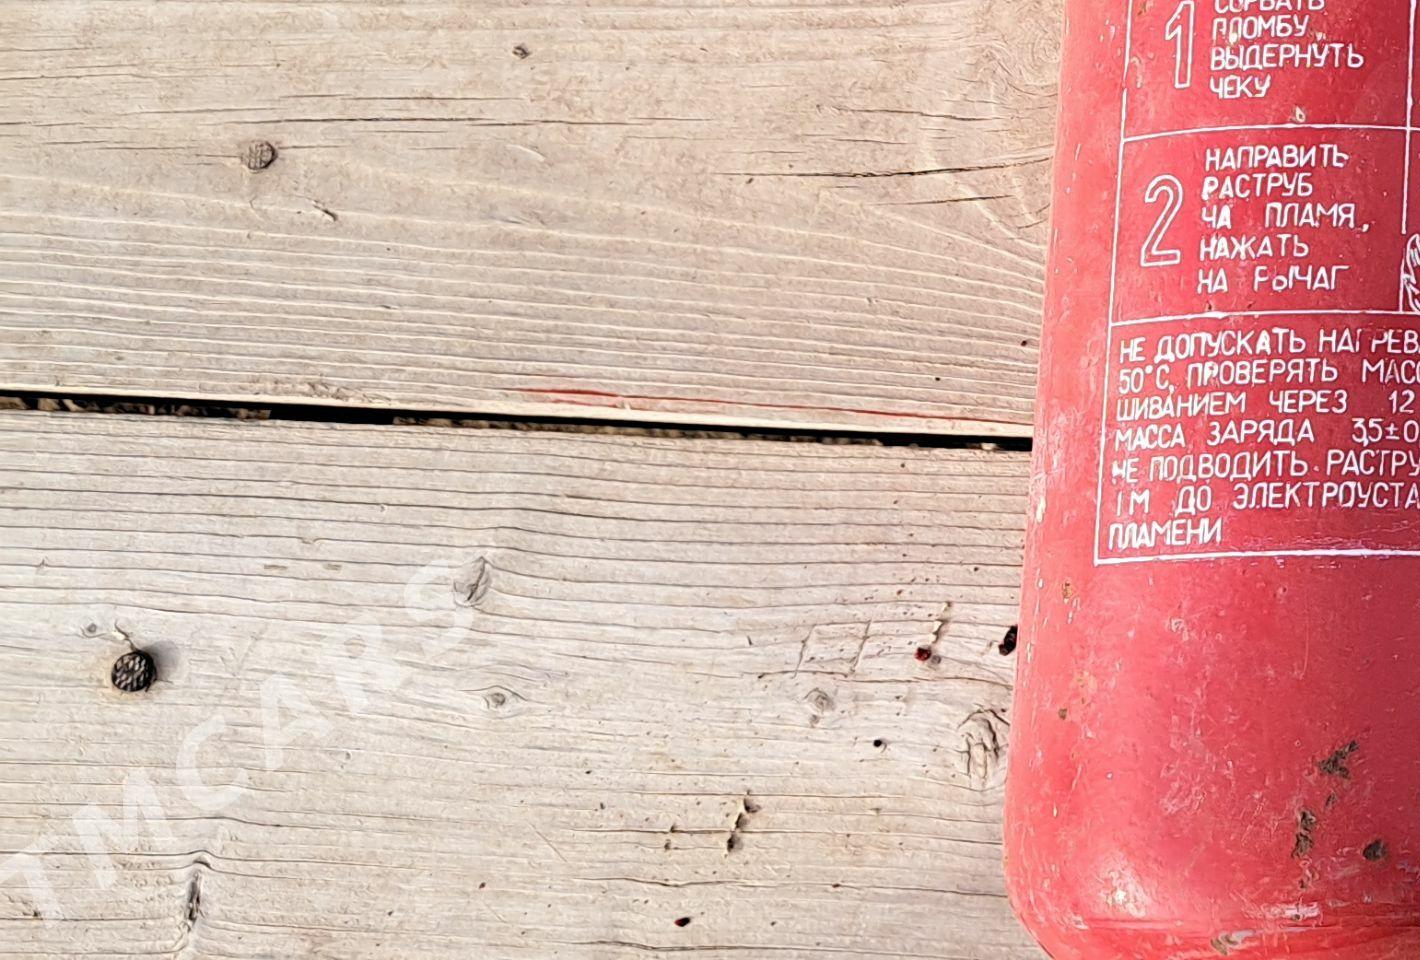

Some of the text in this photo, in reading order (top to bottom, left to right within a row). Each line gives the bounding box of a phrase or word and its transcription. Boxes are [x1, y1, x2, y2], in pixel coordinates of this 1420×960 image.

[1165, 0, 1196, 88] 1
[1210, 43, 1364, 71] ВЫДЕРНУТЬ
[1210, 74, 1271, 99] ЧЕКУ
[1202, 173, 1313, 200] РАСТРУБ
[1140, 144, 1349, 267] 2 НАПРАВИТЬ
[1200, 235, 1309, 263] НАЖАТЬ
[1197, 267, 1228, 293] НА
[1120, 336, 1146, 364] НЕ
[1155, 327, 1307, 362] ДОПУСКАТЬ
[1187, 359, 1338, 388] ПРОВЕРЯТЬ
[1116, 391, 1246, 421] ШИВАНИЕМ
[1269, 390, 1347, 414] ЧЕРЕЗ
[1388, 390, 1414, 414] 12
[1114, 425, 1186, 452] МАССА
[1206, 419, 1315, 446] ЗАРЯДА
[1175, 486, 1212, 516] ДО
[1108, 519, 1223, 549] ПЛАМЕНИ
